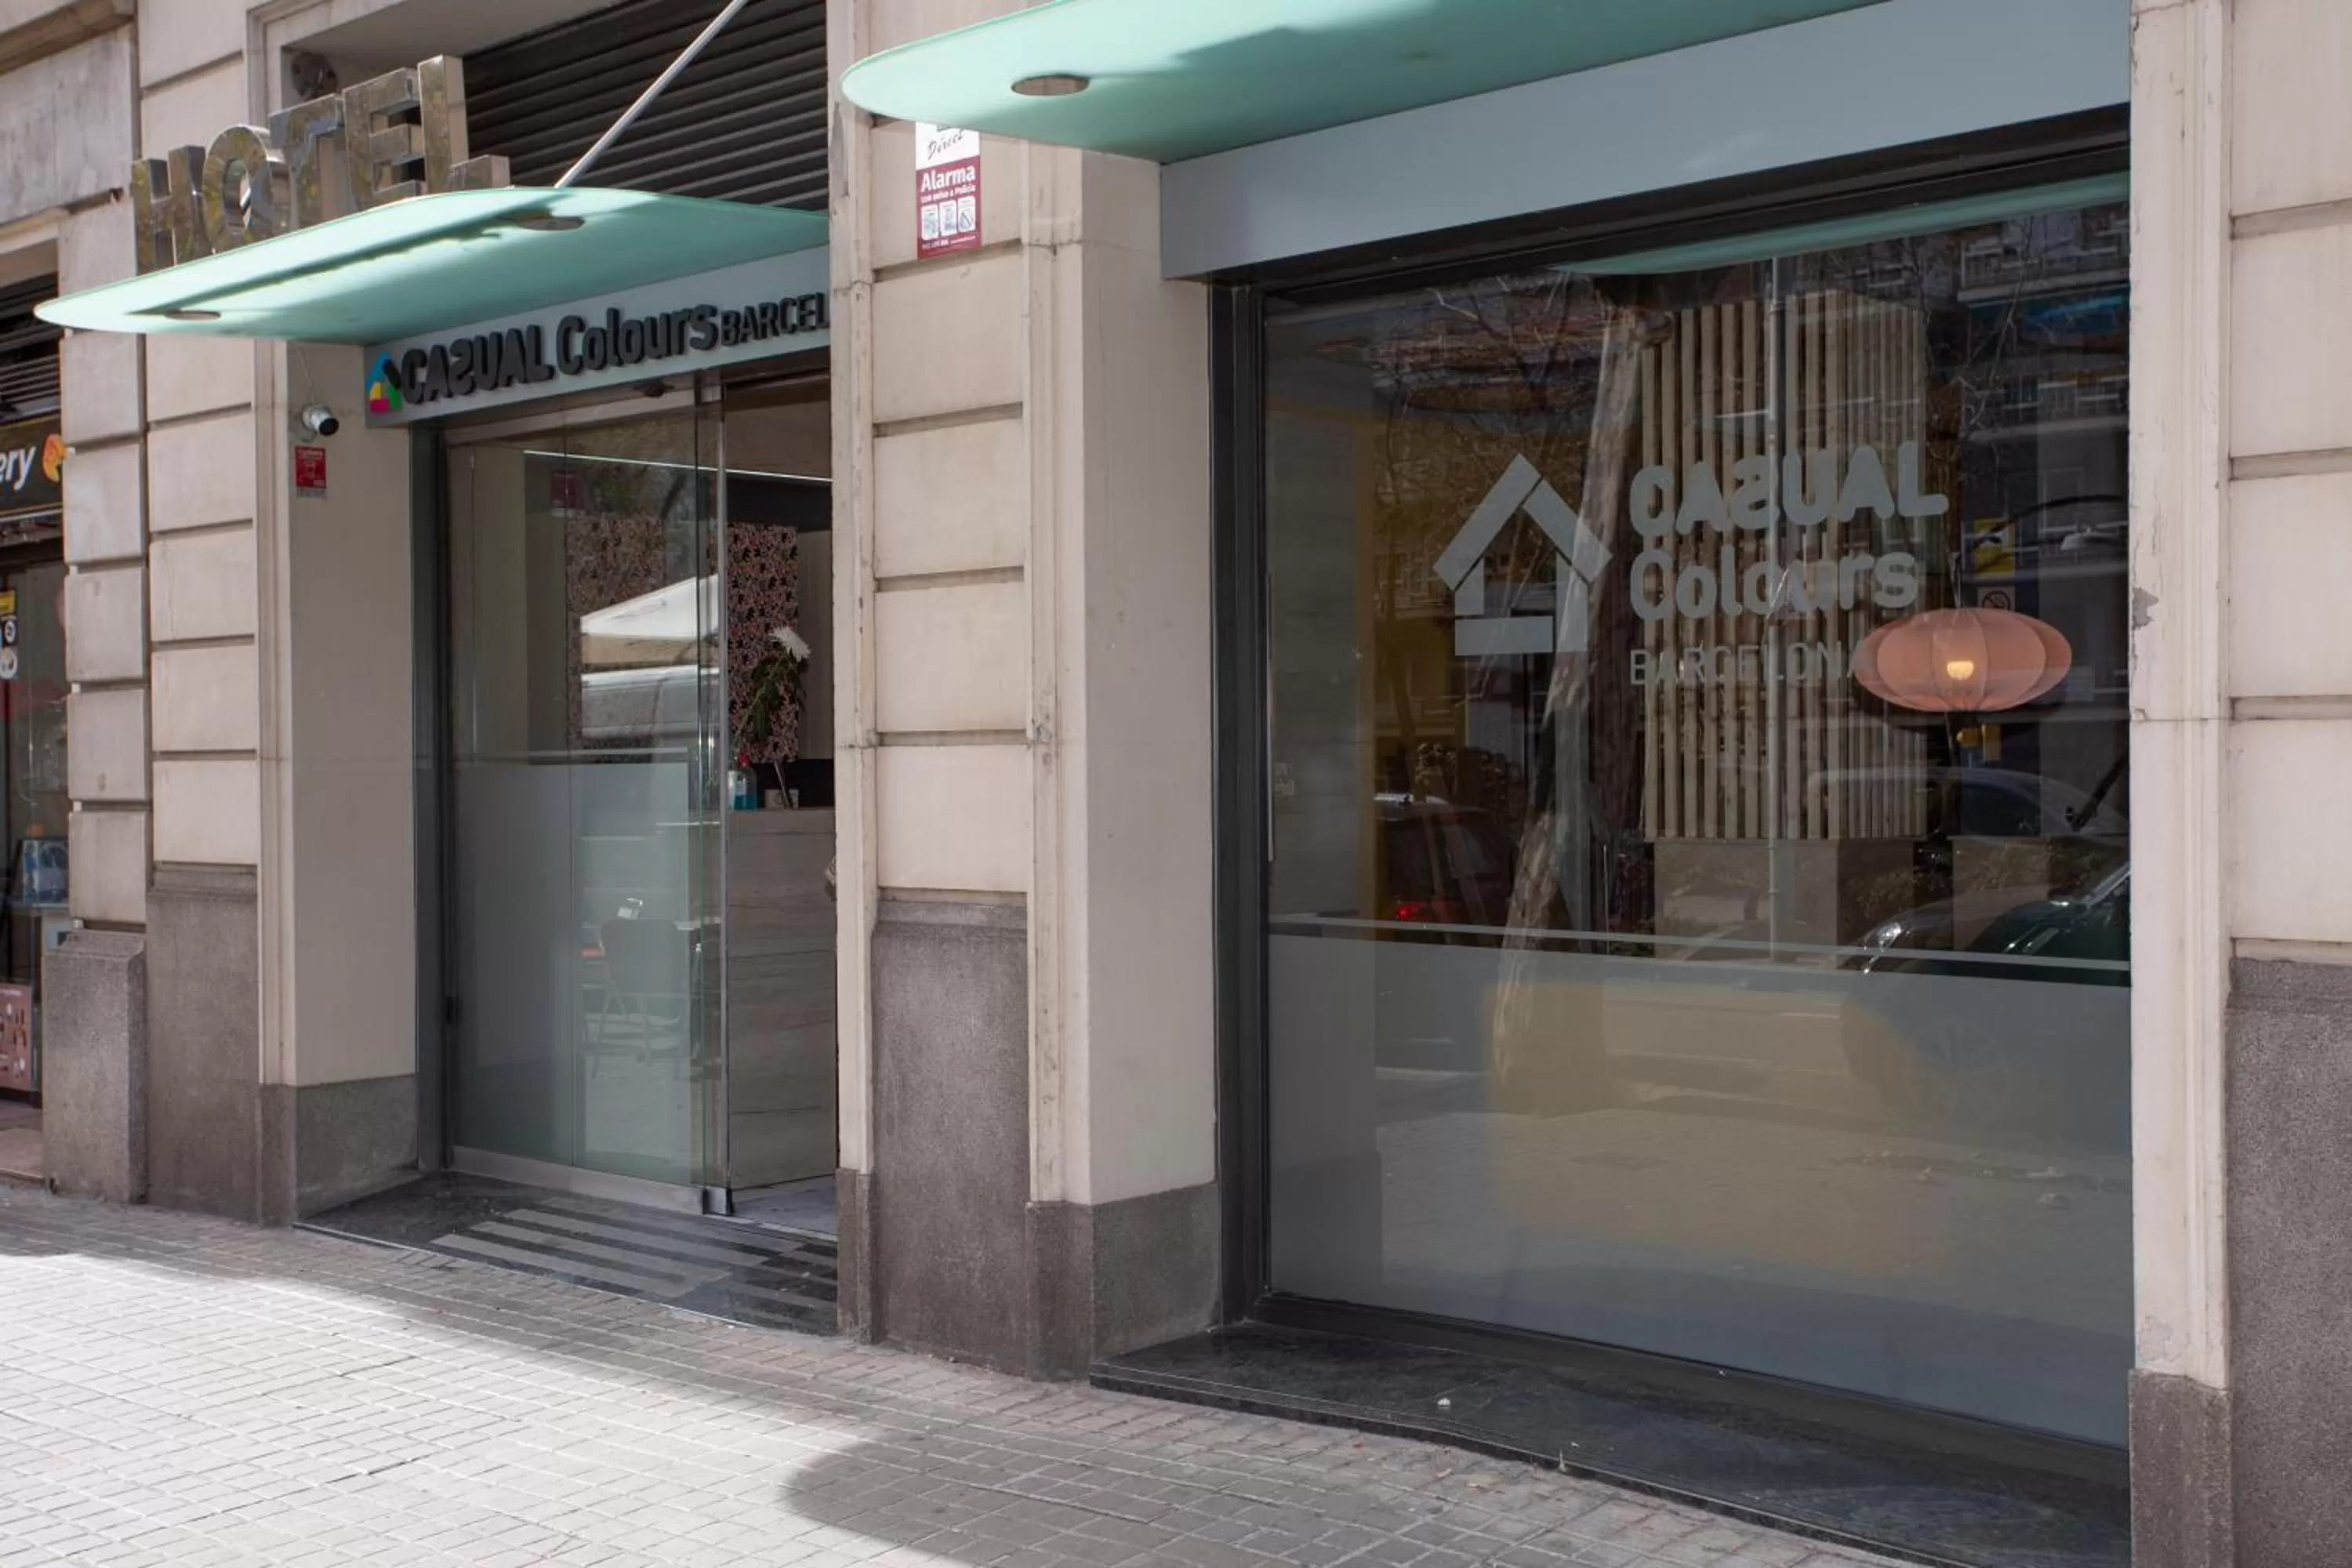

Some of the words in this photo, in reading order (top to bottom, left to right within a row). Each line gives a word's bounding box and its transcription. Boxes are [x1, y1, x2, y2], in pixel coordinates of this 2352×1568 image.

[132, 54, 510, 276] HOTEL
[920, 165, 975, 192] Alarma
[401, 324, 554, 405] CASUAL
[556, 304, 719, 376] Colours
[1629, 441, 1950, 536] CASUAL
[1629, 544, 1918, 621] Colours
